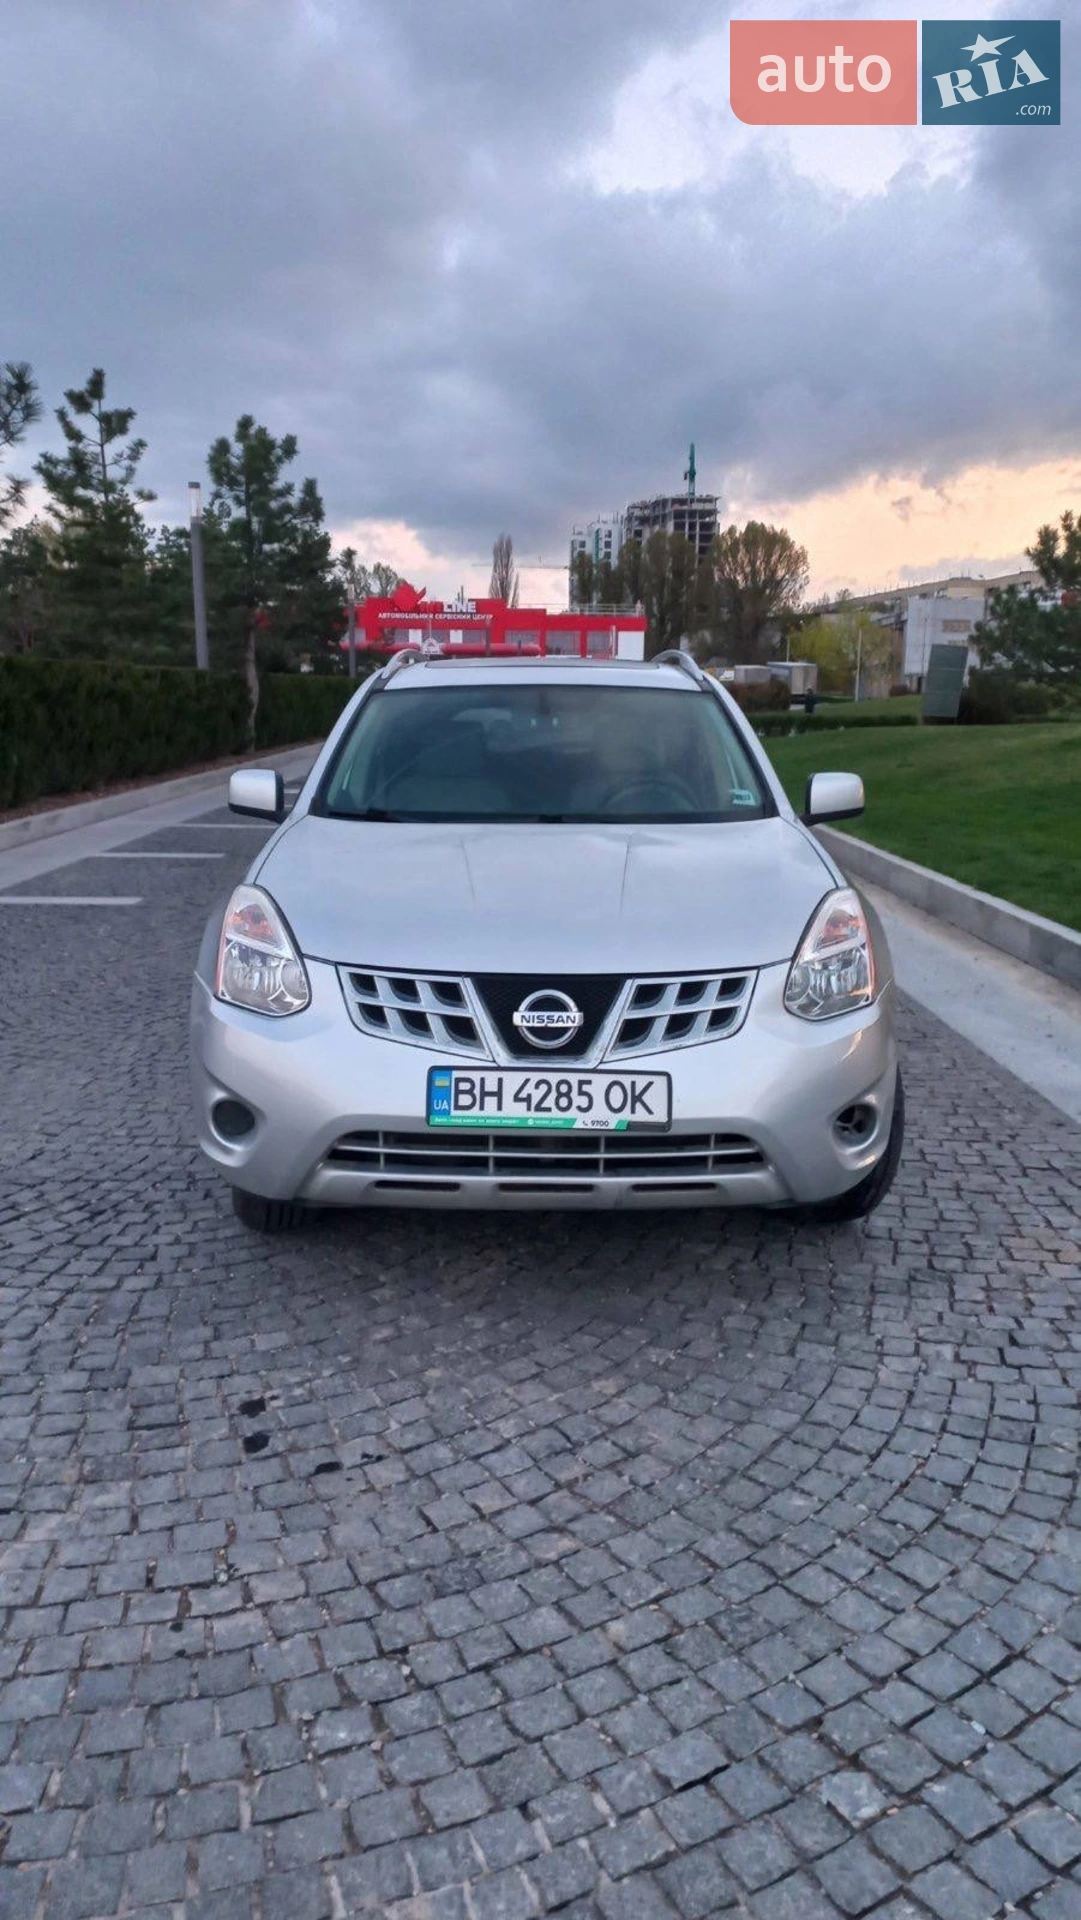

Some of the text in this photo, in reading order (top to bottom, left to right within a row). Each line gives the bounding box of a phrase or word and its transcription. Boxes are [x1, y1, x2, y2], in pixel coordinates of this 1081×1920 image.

[520, 1014, 577, 1025] NISSAN
[453, 1077, 655, 1115] BH 4285 OK
[434, 1099, 449, 1111] UA
[590, 1119, 609, 1127] 9700
